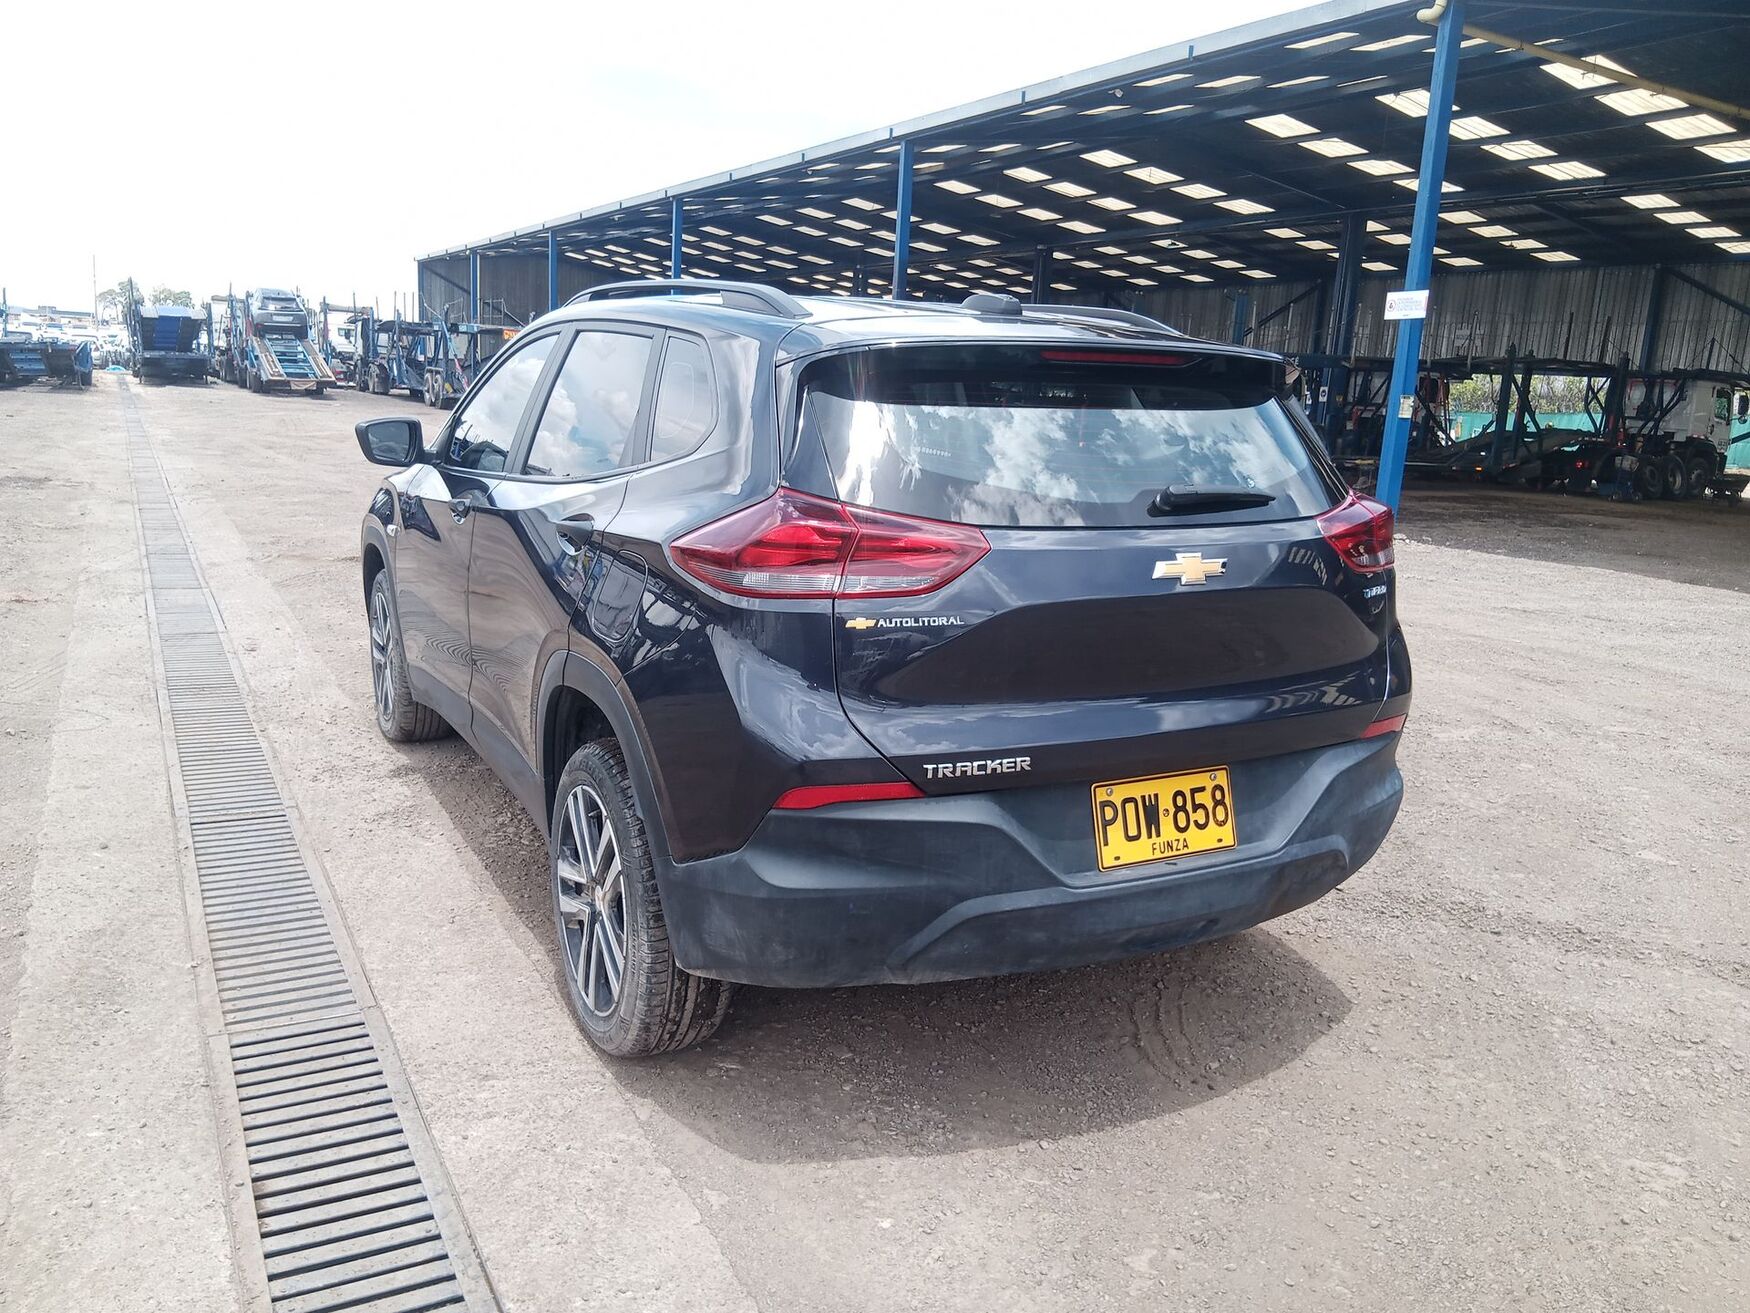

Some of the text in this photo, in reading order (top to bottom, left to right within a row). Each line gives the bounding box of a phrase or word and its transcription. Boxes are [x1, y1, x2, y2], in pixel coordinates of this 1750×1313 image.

[878, 615, 964, 628] AUTOLITORAL
[923, 757, 1032, 779] TRACKER
[1099, 783, 1229, 847] POW 858
[1151, 837, 1190, 856] FUNZA
